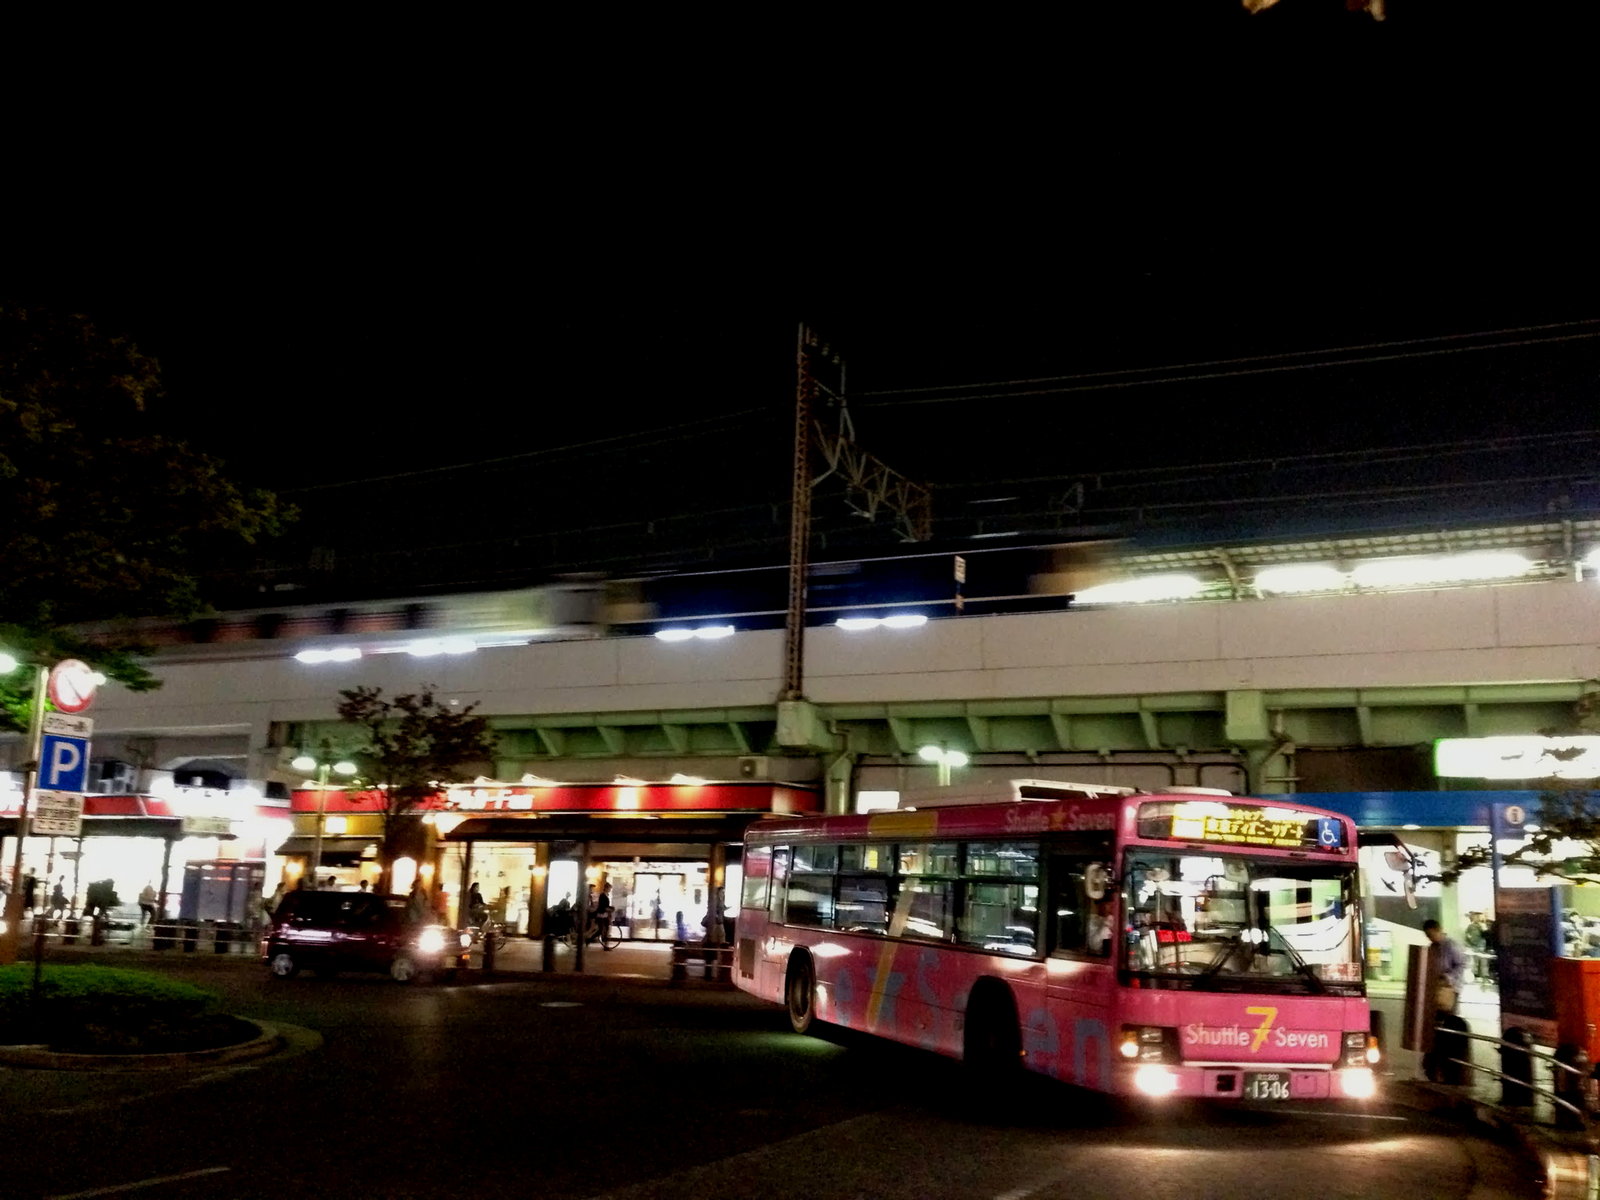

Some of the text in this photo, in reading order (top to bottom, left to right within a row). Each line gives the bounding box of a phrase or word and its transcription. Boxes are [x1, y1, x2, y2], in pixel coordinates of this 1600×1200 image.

[48, 741, 80, 785] P
[1005, 804, 1117, 833] Shuttle Seven
[1185, 1006, 1329, 1053] Shuttle 7 Seven
[1252, 1080, 1290, 1099] 13-06
